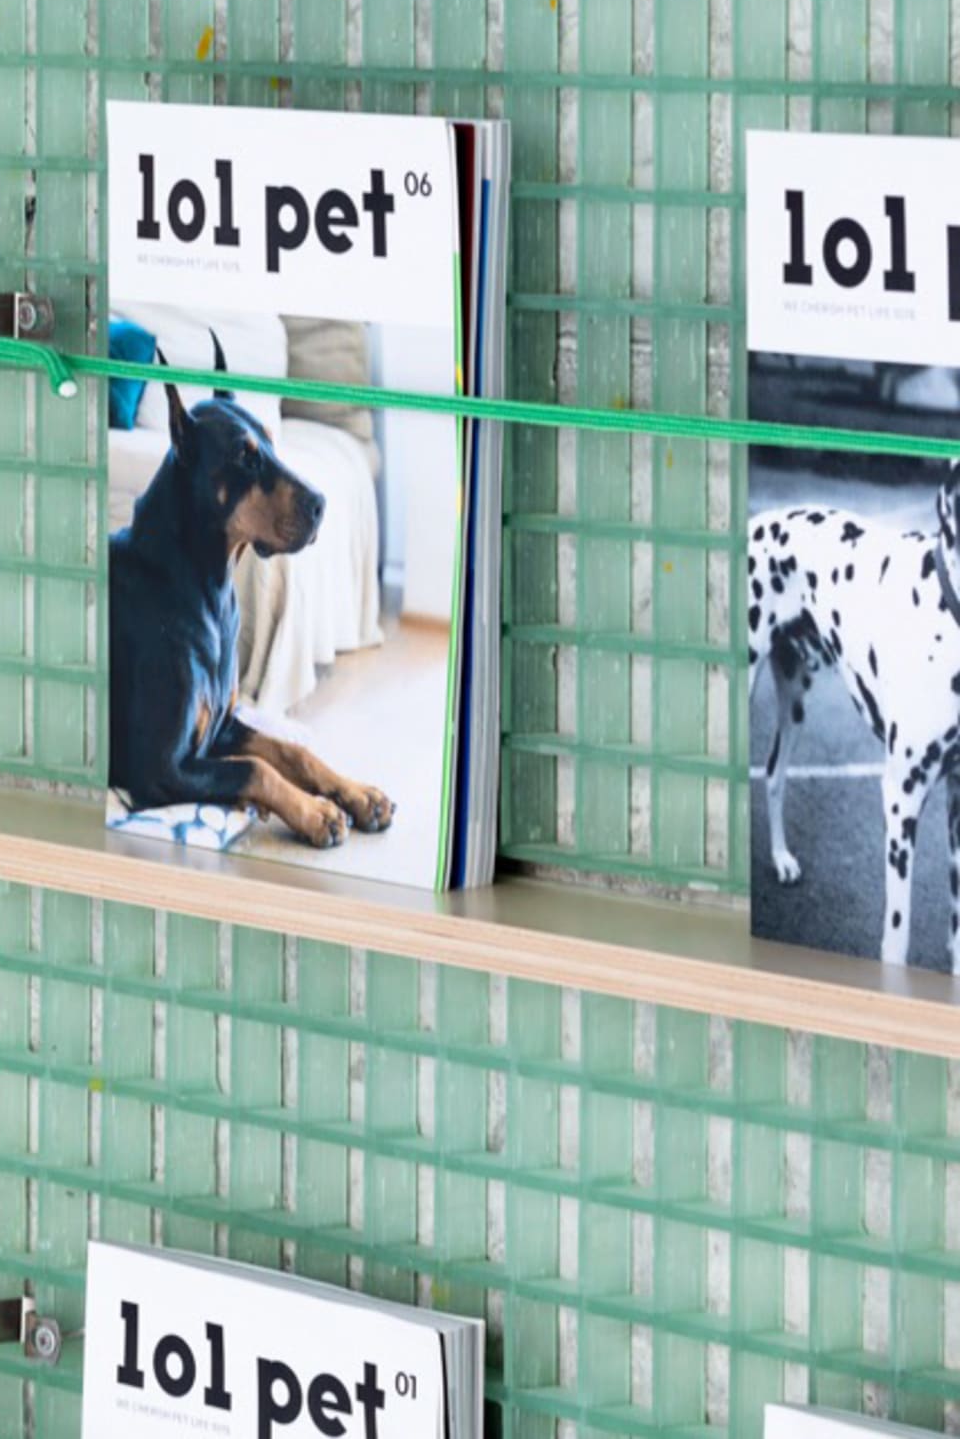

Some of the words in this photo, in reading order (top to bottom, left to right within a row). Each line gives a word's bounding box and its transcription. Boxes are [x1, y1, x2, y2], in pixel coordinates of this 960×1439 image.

[136, 153, 240, 247] lol
[264, 168, 395, 274] pet
[404, 171, 432, 197] 06
[783, 189, 916, 293] lol
[116, 1300, 232, 1411] lol
[256, 1357, 386, 1439] pet
[395, 1371, 417, 1400] 01
